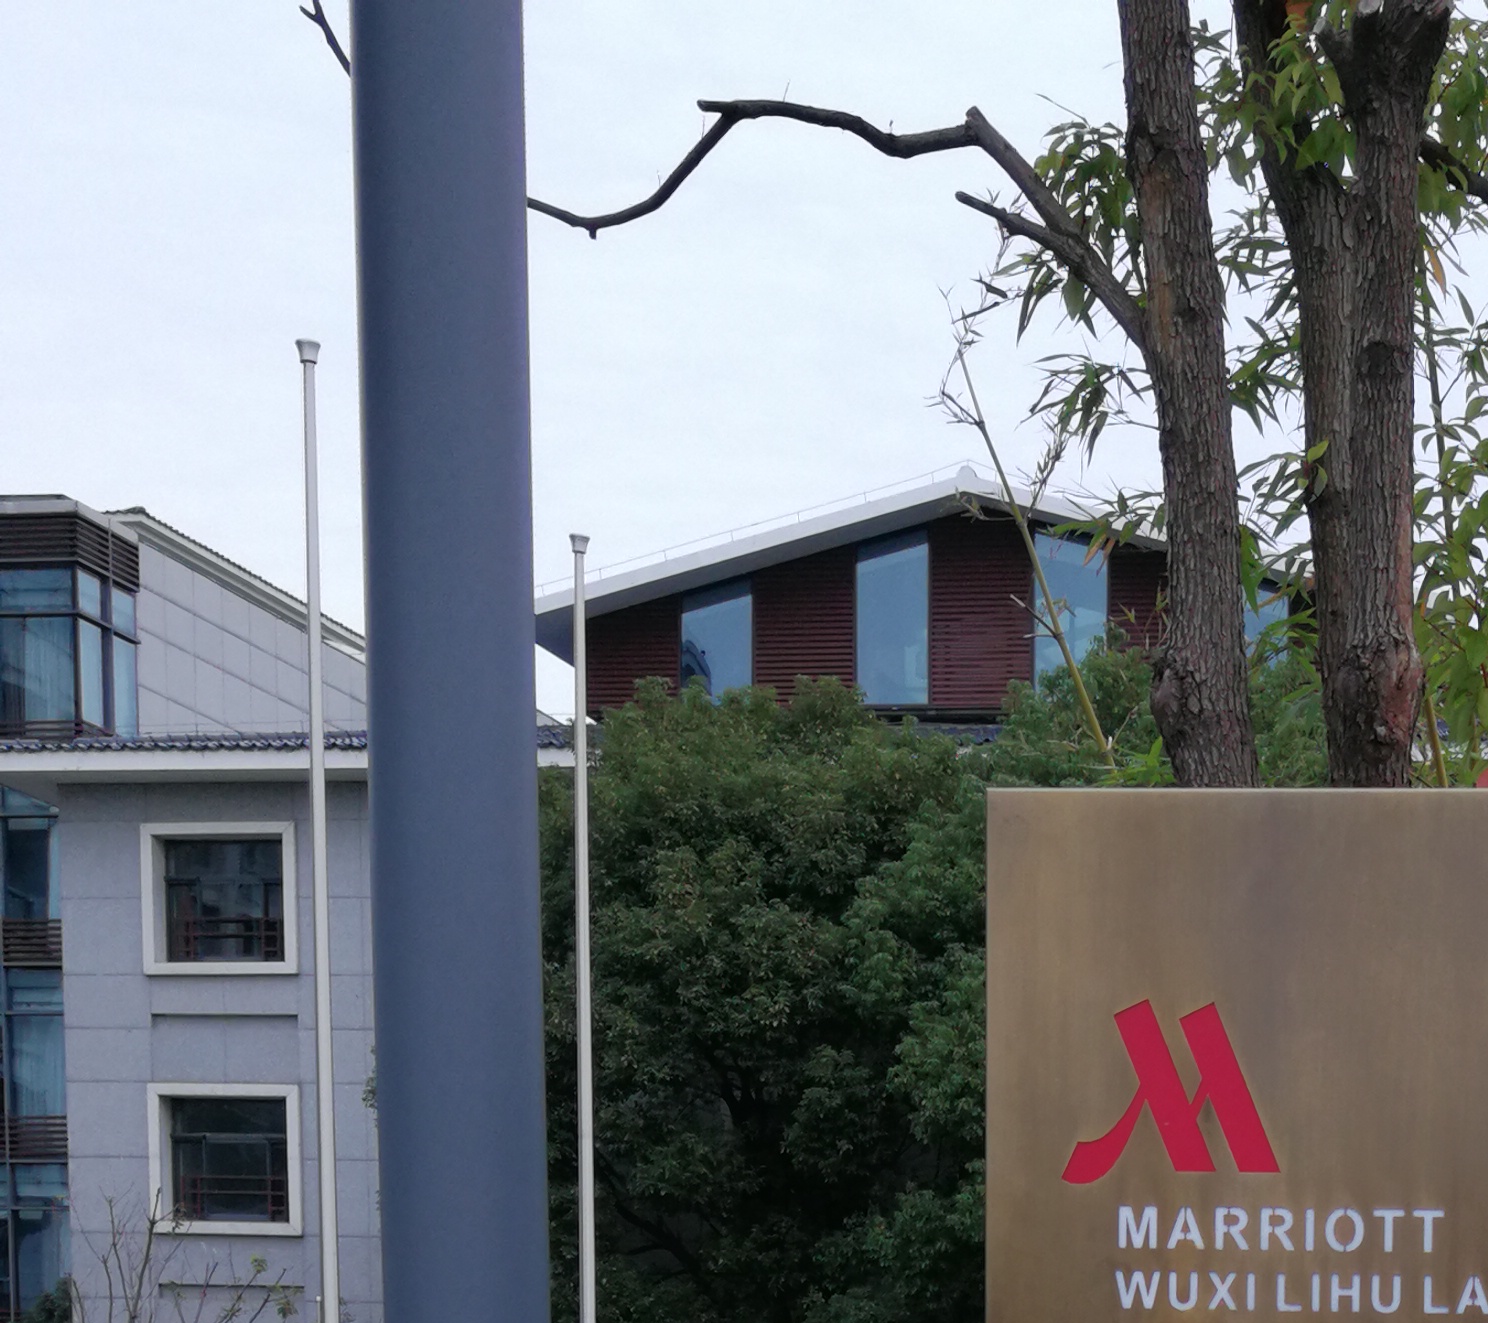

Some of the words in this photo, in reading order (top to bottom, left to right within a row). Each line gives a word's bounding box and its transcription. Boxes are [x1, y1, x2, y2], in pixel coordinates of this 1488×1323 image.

[1118, 1205, 1445, 1253] MARRIOTT
[1115, 1270, 1257, 1312] WUXI
[1276, 1273, 1402, 1314] LIHU
